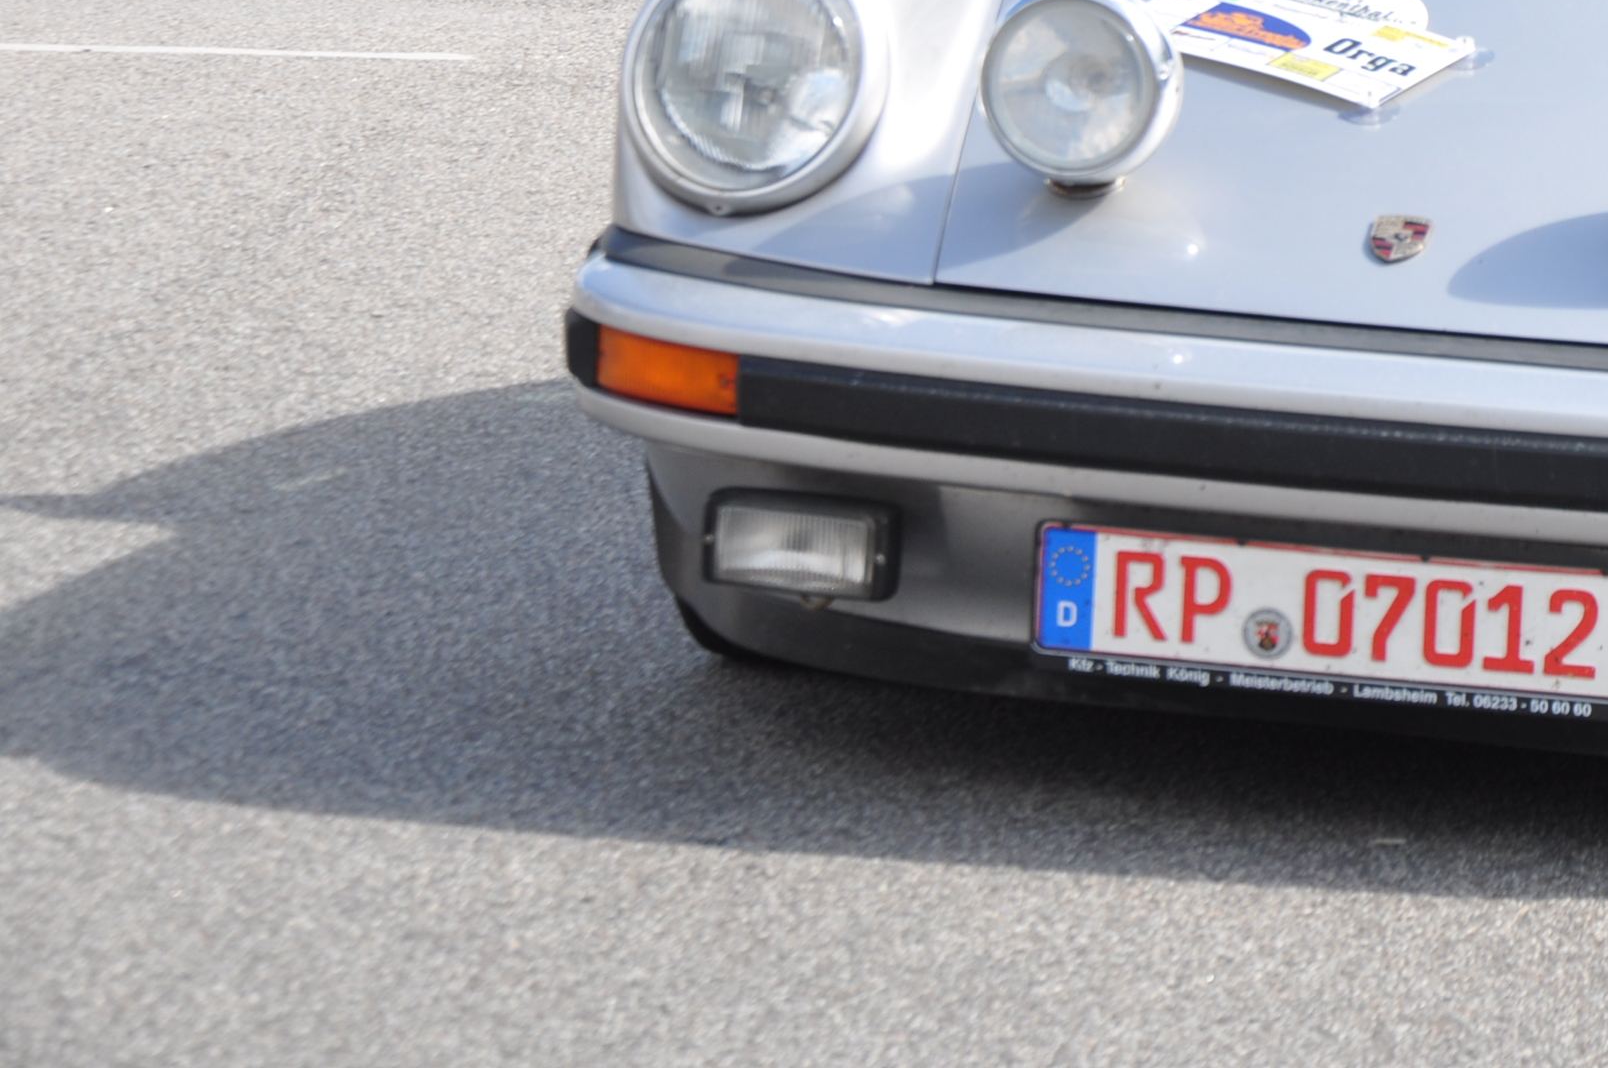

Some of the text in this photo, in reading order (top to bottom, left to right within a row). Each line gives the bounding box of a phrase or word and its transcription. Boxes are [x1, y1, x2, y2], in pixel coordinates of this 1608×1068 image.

[1322, 37, 1418, 77] Orga
[1056, 600, 1078, 628] D
[1112, 550, 1600, 680] RP 07012
[1166, 666, 1211, 687] König
[1229, 673, 1334, 696] Meisterbetrieb
[1353, 684, 1438, 705] Lambsheim
[1445, 692, 1470, 707] Tel.
[1472, 695, 1518, 712] 06233
